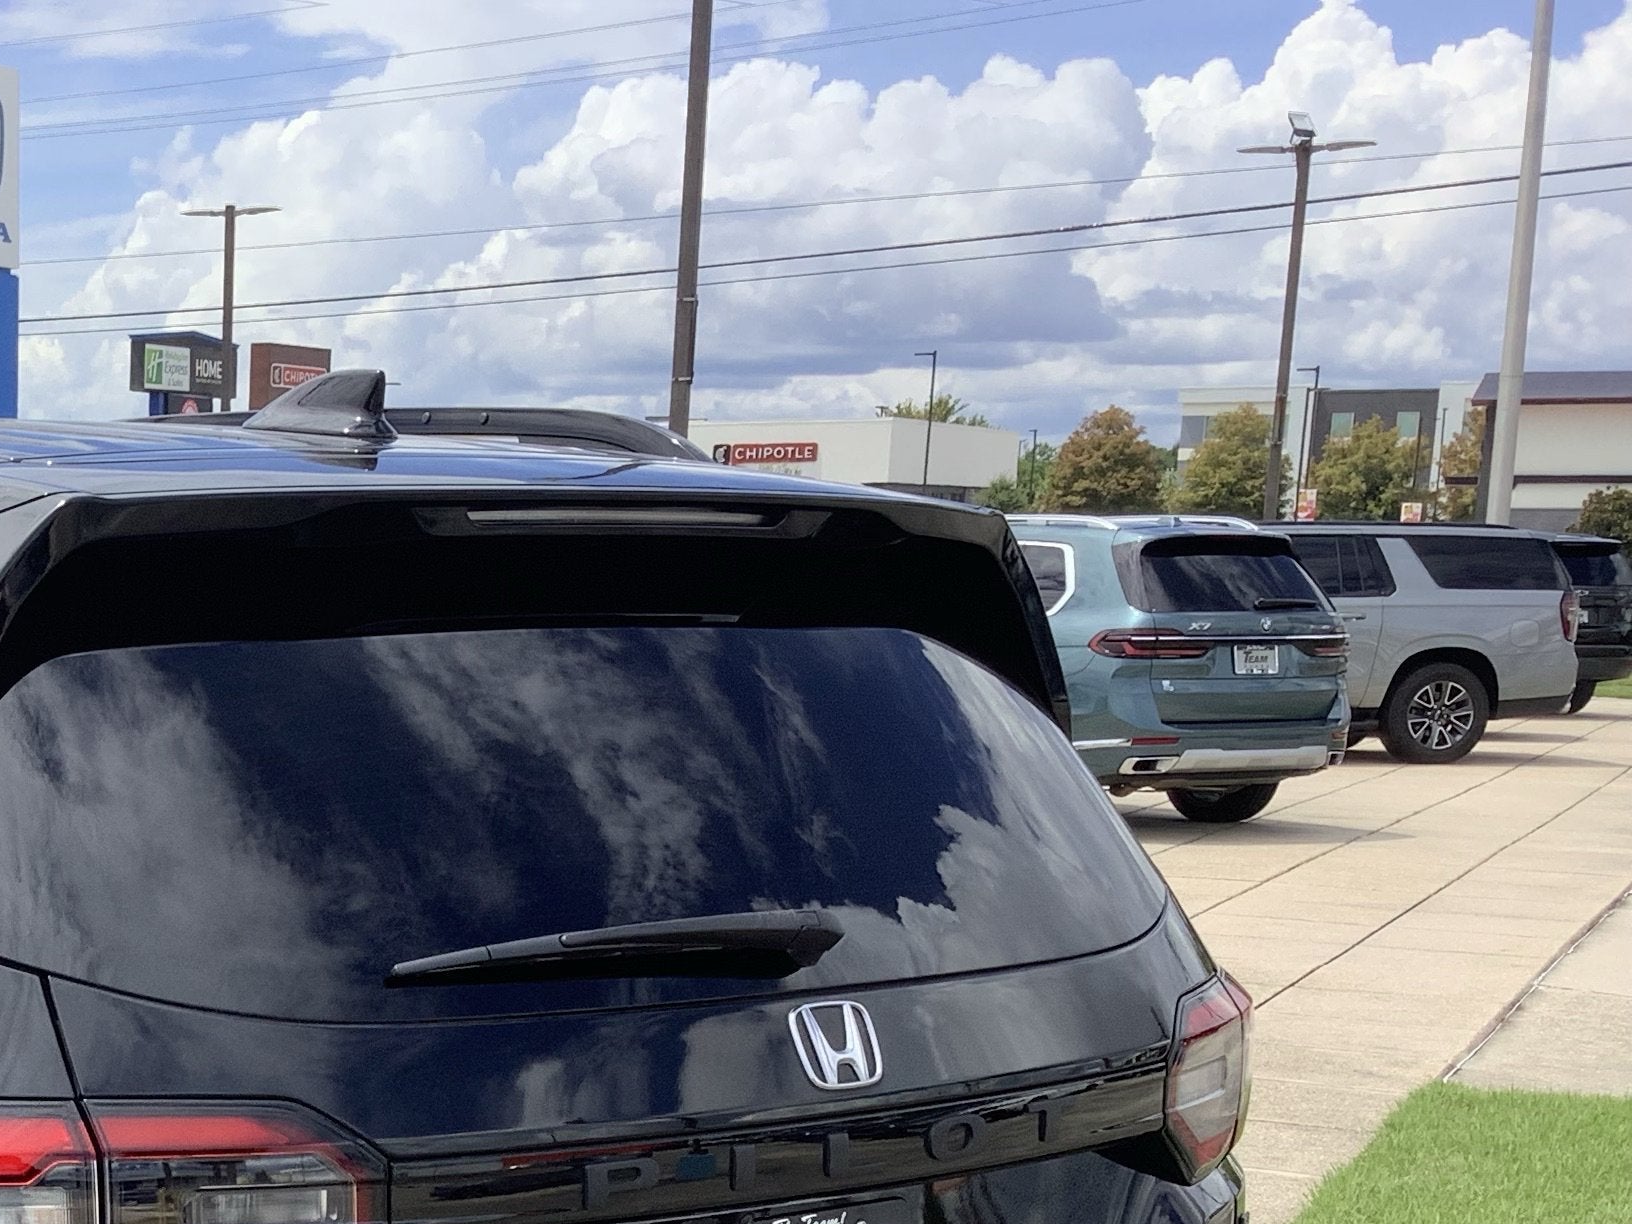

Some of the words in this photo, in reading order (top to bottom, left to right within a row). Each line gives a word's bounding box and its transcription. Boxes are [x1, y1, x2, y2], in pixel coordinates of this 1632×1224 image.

[195, 358, 223, 379] HOME
[735, 446, 813, 460] CHIPOTLE
[1188, 621, 1212, 631] X7
[584, 1096, 1052, 1209] PILOT
